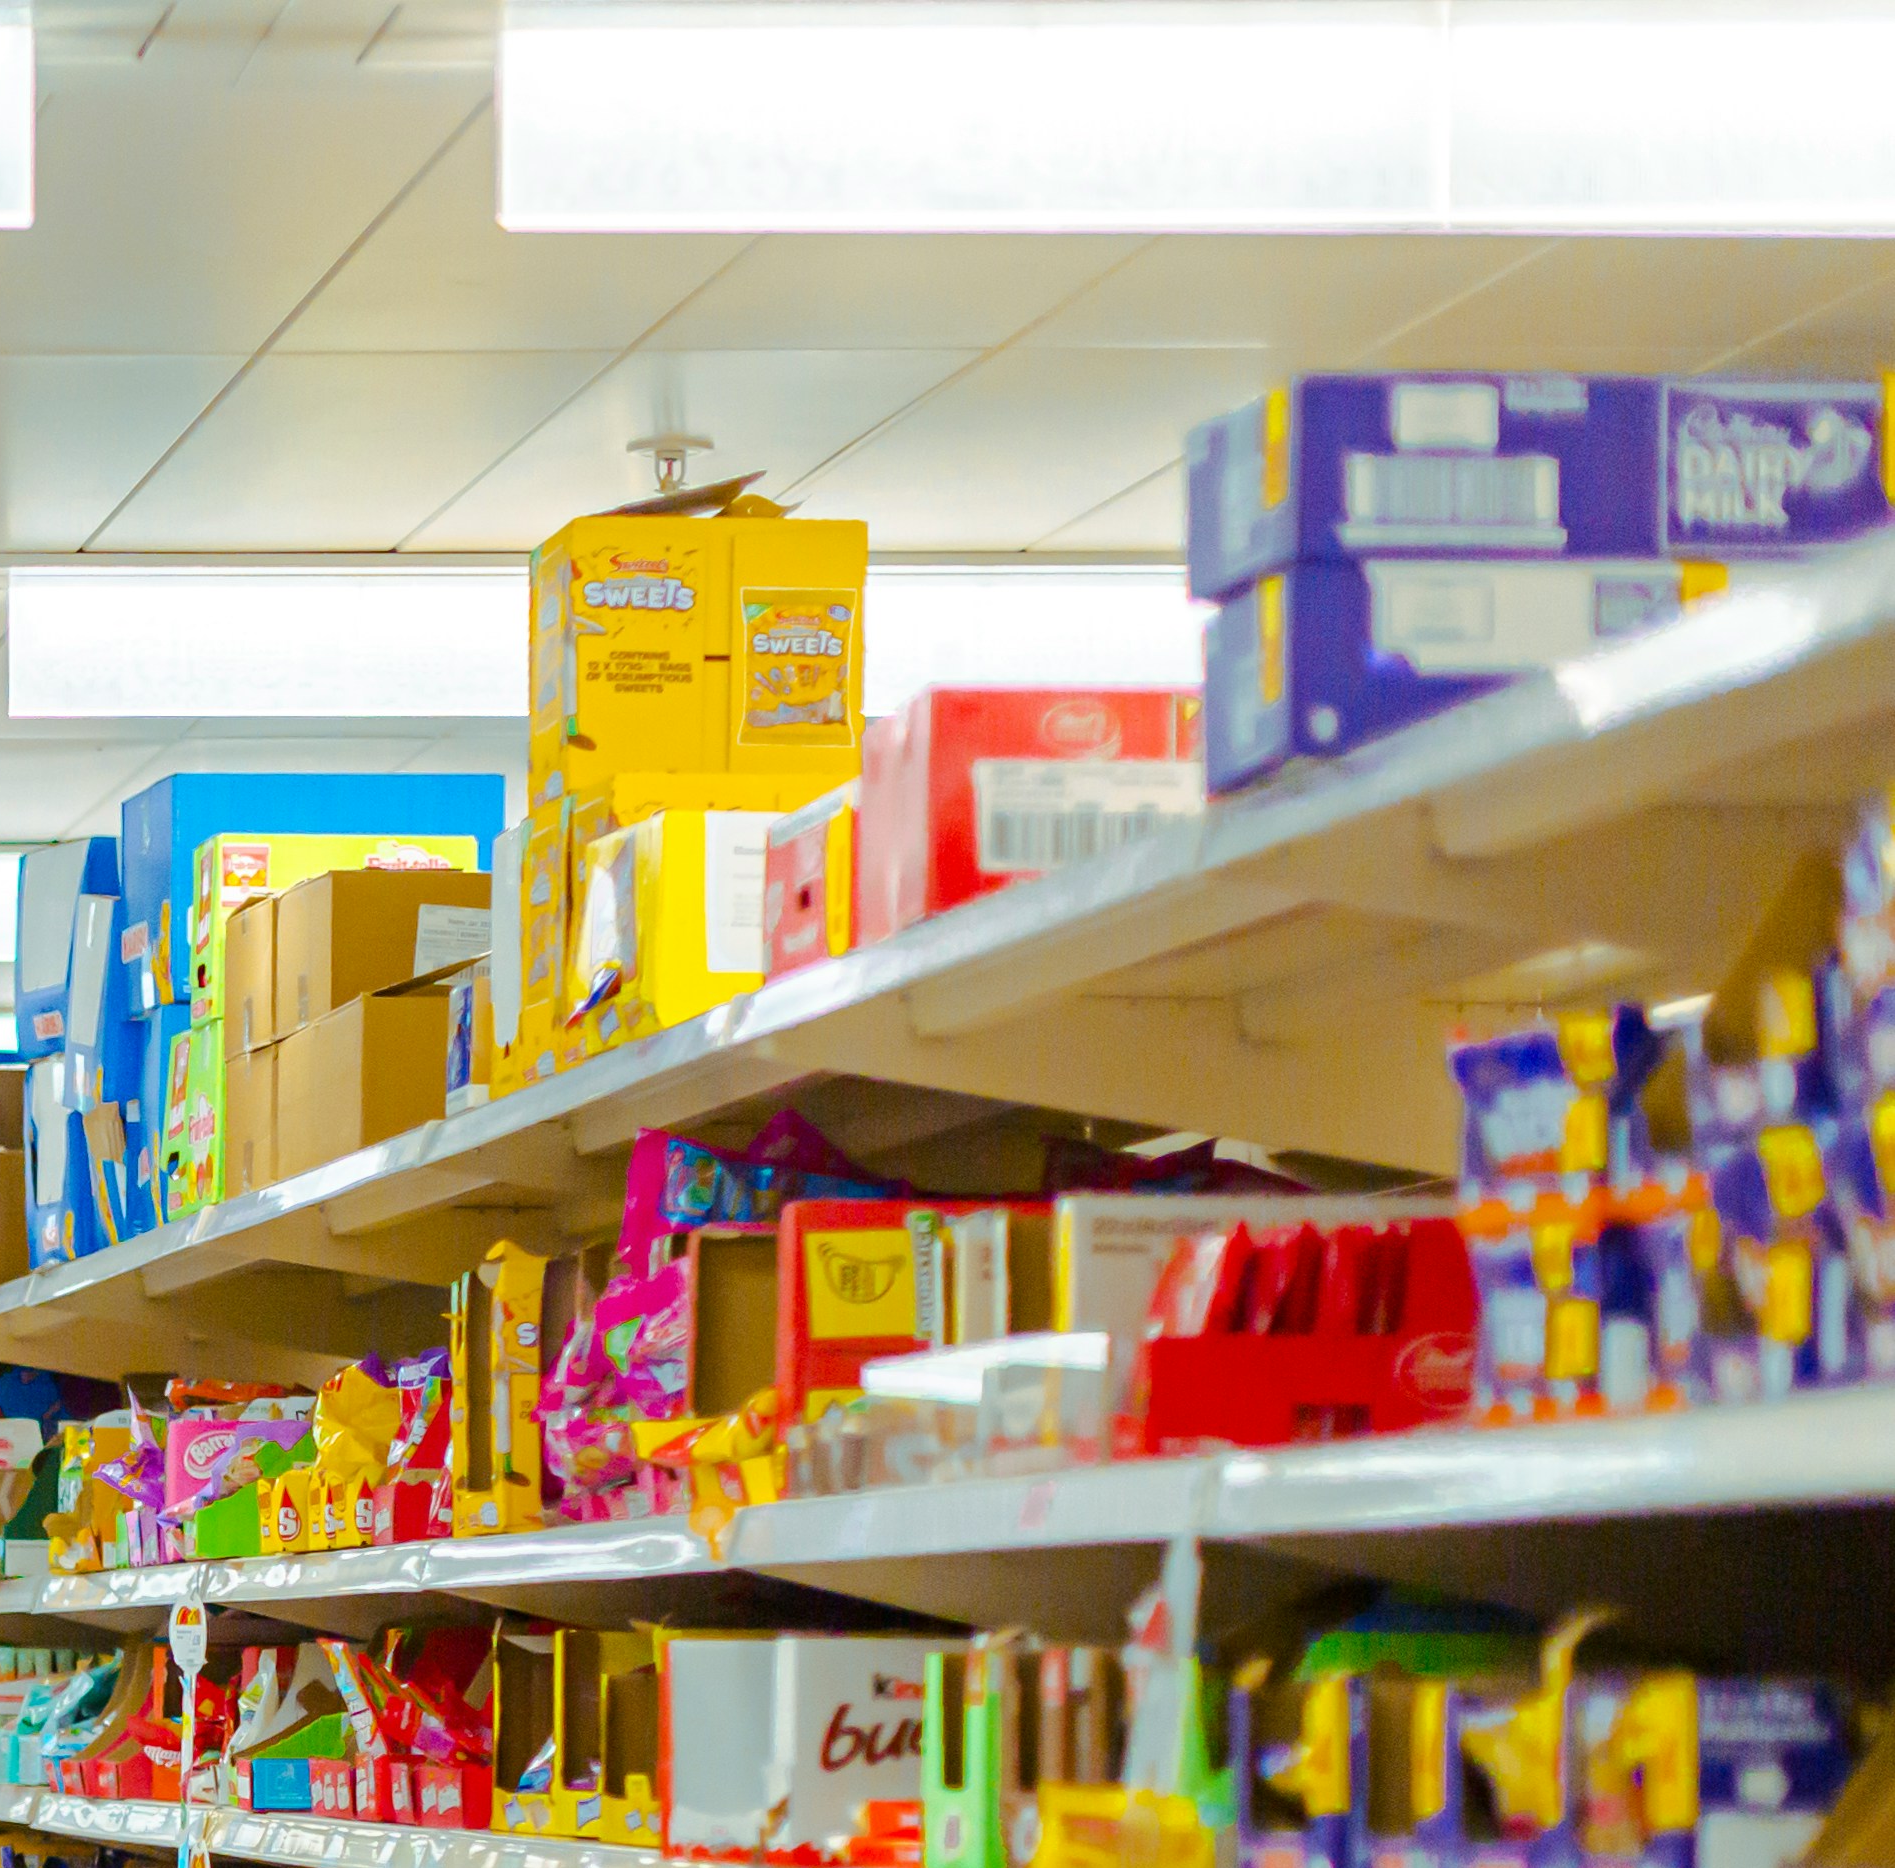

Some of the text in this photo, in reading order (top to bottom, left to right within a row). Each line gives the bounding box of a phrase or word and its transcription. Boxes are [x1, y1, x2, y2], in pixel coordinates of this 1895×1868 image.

[583, 577, 696, 612] SWEETS
[752, 630, 844, 657] SWEETS
[190, 1435, 236, 1465] Barra
